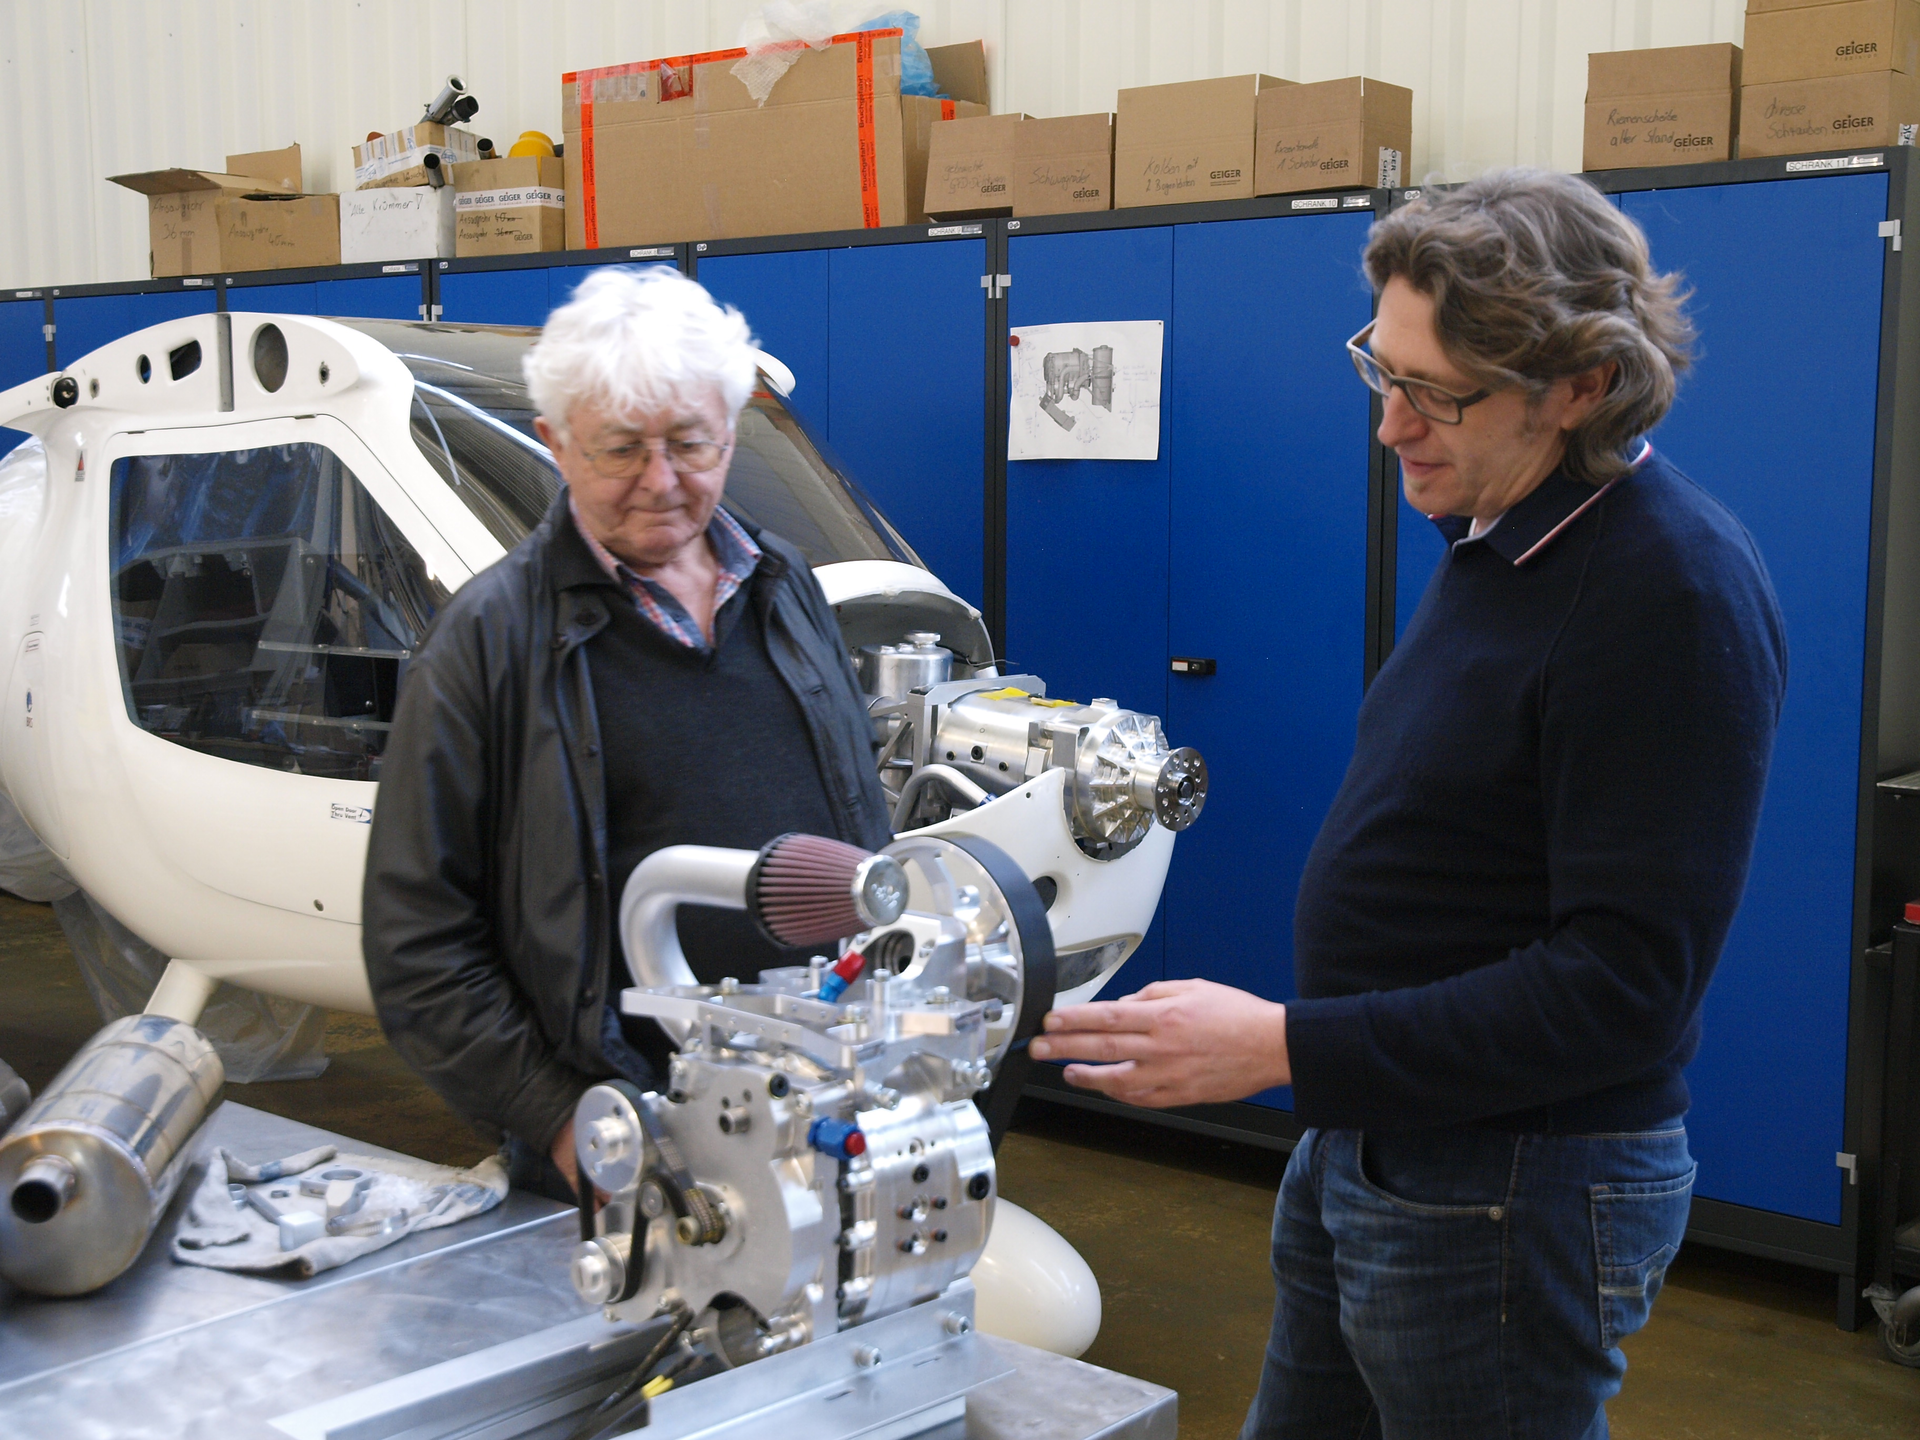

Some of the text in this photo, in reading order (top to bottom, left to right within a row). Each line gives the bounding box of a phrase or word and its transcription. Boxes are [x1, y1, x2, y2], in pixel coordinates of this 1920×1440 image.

[860, 139, 868, 191] Bruchgefahr!
[1788, 160, 1833, 171] SCHRANK
[1836, 159, 1846, 168] 11
[1293, 200, 1327, 209] SCHRANK
[1328, 199, 1337, 207] 10
[930, 228, 955, 236] SCHRANK
